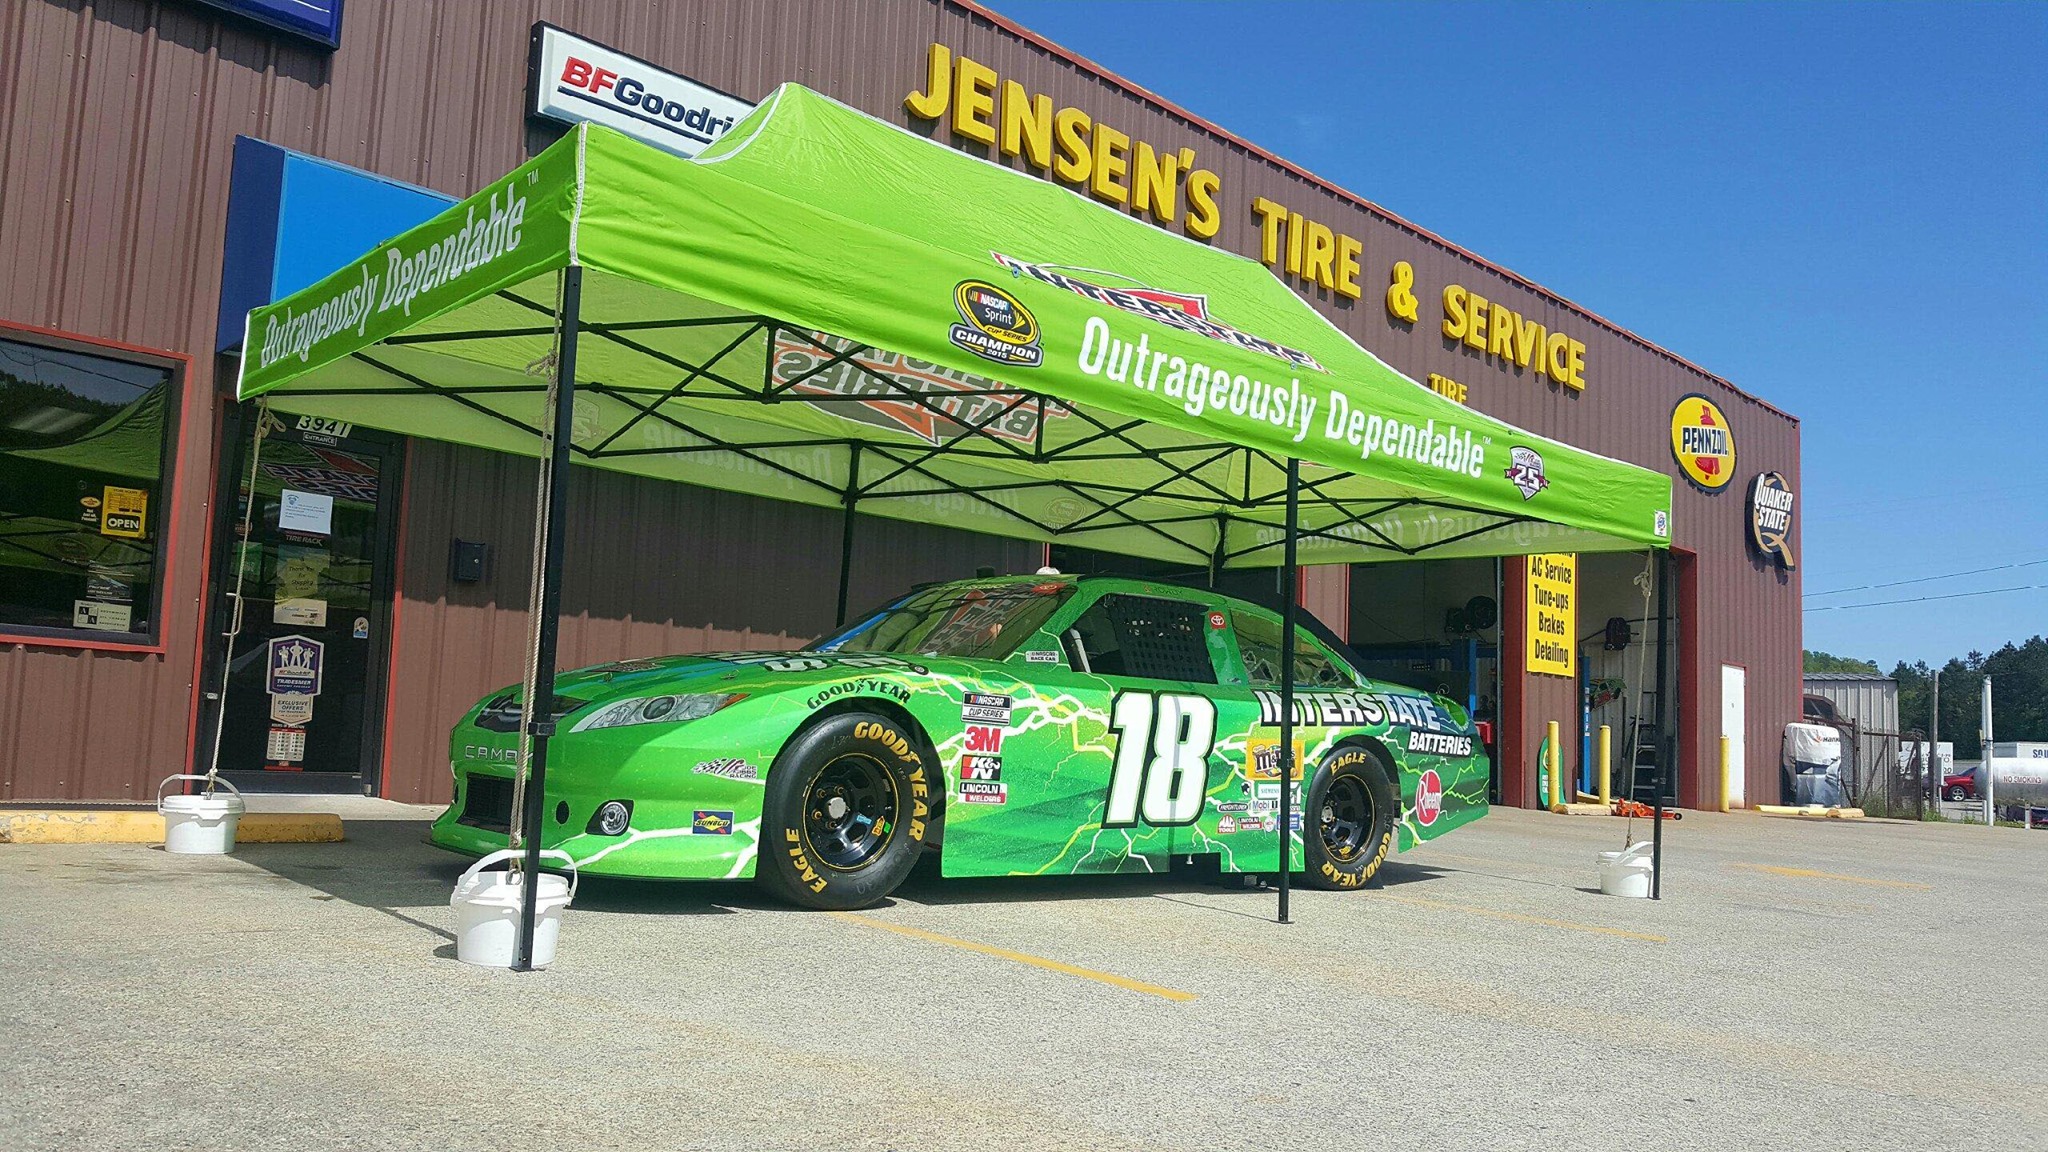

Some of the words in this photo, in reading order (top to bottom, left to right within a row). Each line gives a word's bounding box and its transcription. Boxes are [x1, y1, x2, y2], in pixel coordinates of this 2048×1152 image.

[561, 56, 734, 136] BFGoodri
[904, 43, 1221, 238] JENSEN'S
[1253, 197, 1362, 299] TIRE
[1387, 261, 1419, 323] &
[1443, 284, 1586, 392] SERVICE
[261, 264, 379, 362] Outrageously
[378, 182, 527, 316] Dependable
[981, 293, 1010, 310] NASCAR
[985, 307, 1012, 325] Sprint
[956, 330, 1036, 359] CHAMPION
[1002, 331, 1028, 342] SERIES
[986, 348, 1007, 358] 2015
[1078, 316, 1317, 442] Outrageously
[1324, 390, 1485, 478] Dependable
[300, 415, 347, 436] 3941
[304, 433, 336, 445] ENTRANCE
[1682, 427, 1729, 456] PENNZOIL
[1514, 463, 1540, 491] 25
[1754, 473, 1793, 511] QUAKER
[108, 518, 139, 529] OPEN
[1758, 507, 1787, 530] STATE
[286, 534, 302, 542] TIRE
[303, 536, 323, 547] RACK
[1531, 556, 1543, 577] AC
[1545, 559, 1572, 584] Service
[1534, 584, 1568, 613] Tune-ups
[1538, 611, 1565, 635] Brakes
[1535, 639, 1569, 668] Detailing
[807, 678, 912, 709] GOODYEAR
[979, 695, 1004, 706] NASCAR
[969, 708, 981, 716] CUP
[982, 708, 1004, 718] SERIES
[1254, 690, 1441, 731] INTERSTATE
[965, 726, 1001, 752] 3M
[1409, 731, 1472, 756] BATTERIES
[1105, 690, 1216, 826] 18
[1330, 752, 1366, 775] EAGLE
[854, 721, 928, 842] GOODYEAR
[961, 783, 999, 793] LINCOLN
[2003, 775, 2012, 783] NO
[2014, 775, 2042, 784] SMOKING
[969, 794, 1001, 802] WELDERS
[785, 828, 828, 894] EAGLE
[1321, 832, 1391, 887] GOODYEAR
